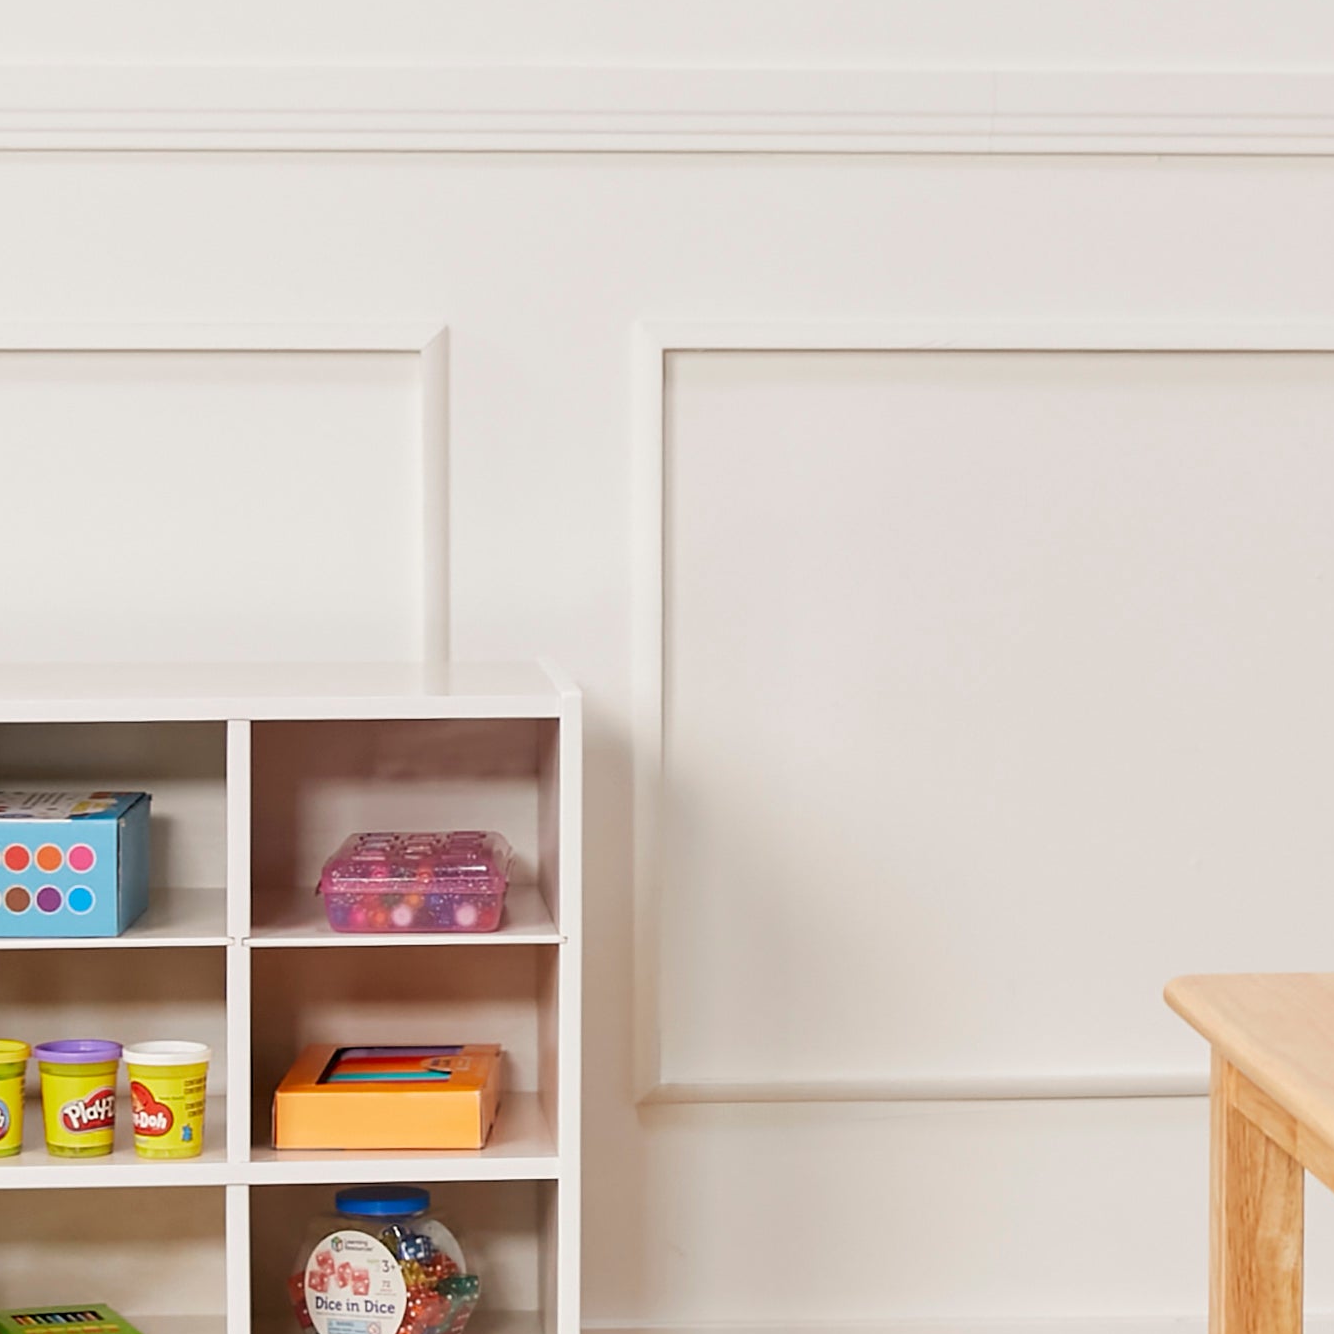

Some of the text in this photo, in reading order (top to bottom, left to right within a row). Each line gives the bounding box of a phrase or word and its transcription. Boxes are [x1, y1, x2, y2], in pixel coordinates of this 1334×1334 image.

[315, 1296, 396, 1315] Dice in Dice
